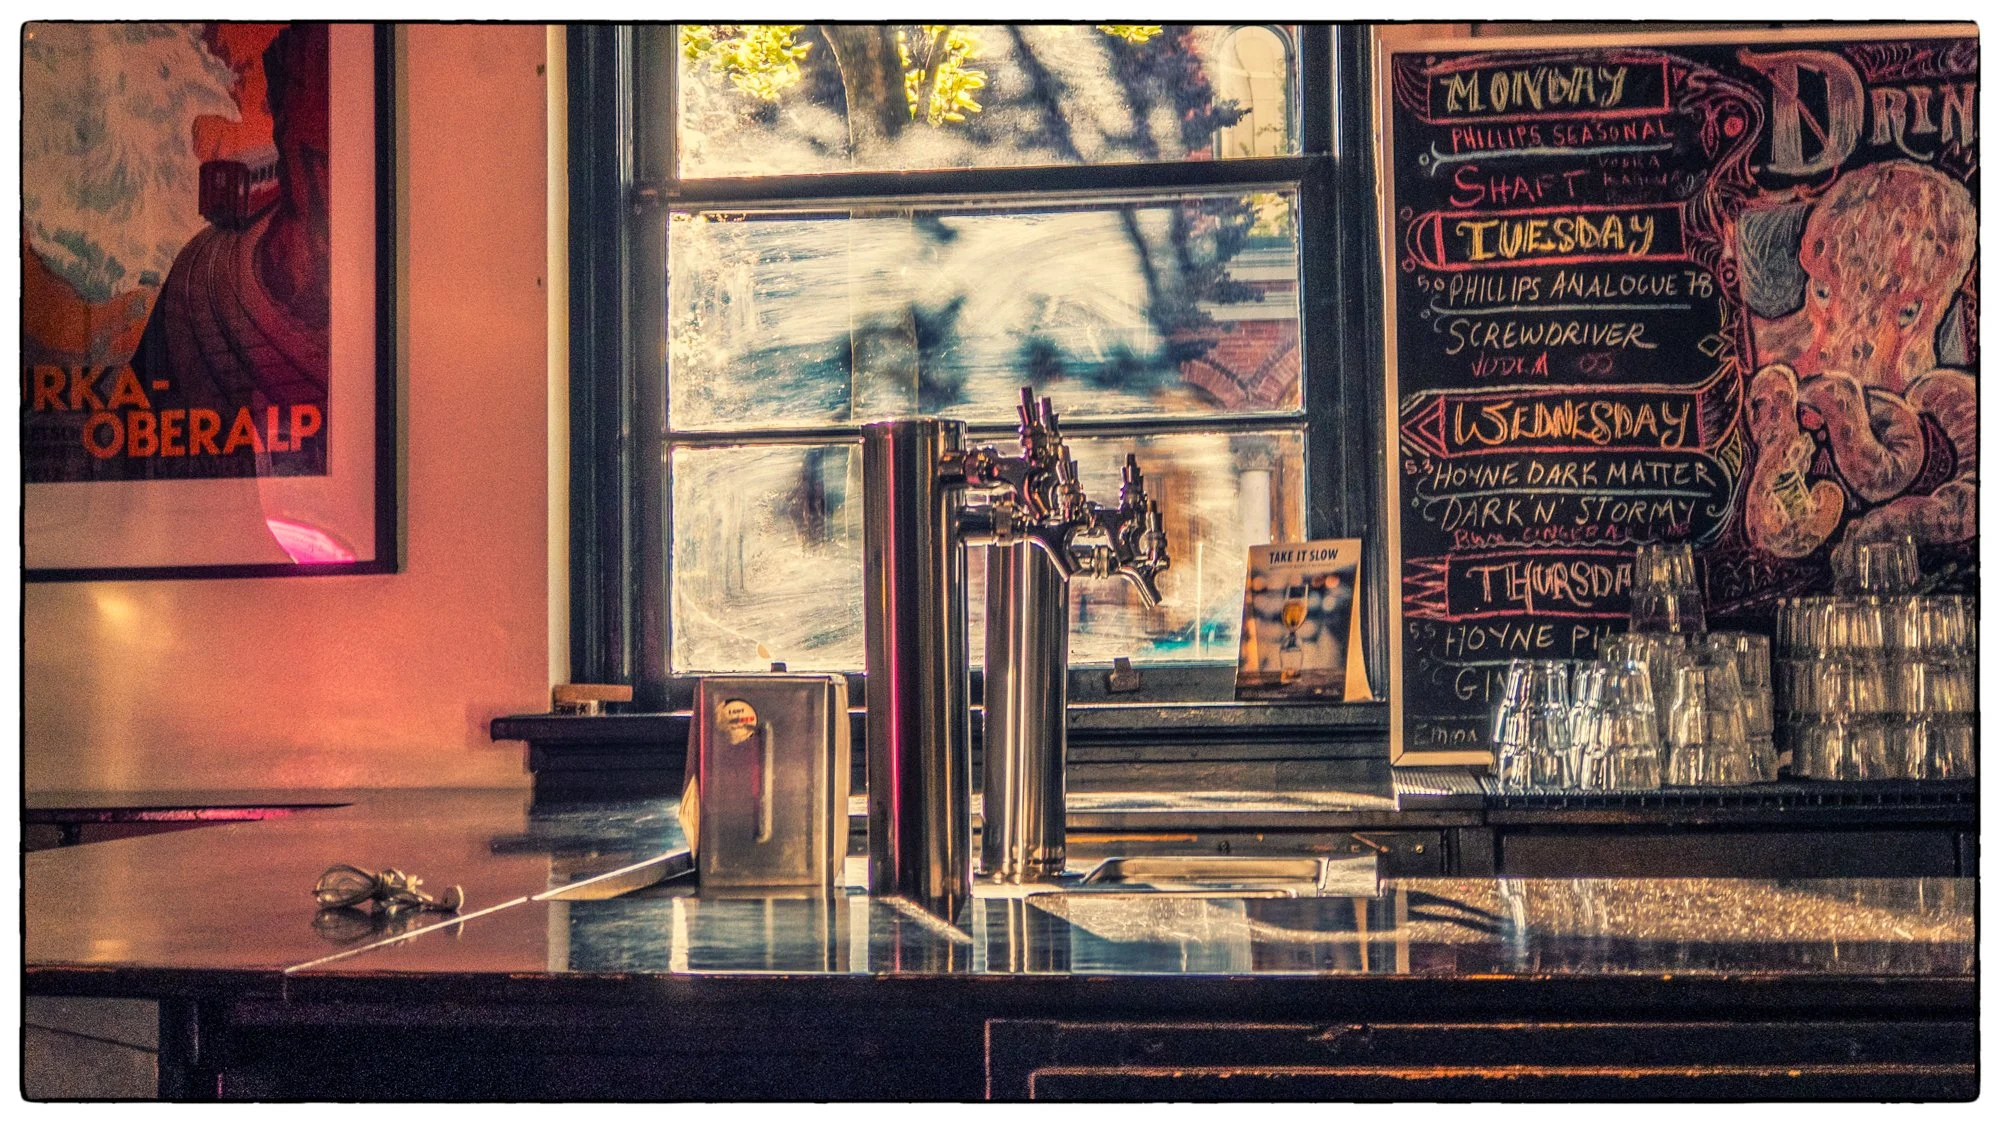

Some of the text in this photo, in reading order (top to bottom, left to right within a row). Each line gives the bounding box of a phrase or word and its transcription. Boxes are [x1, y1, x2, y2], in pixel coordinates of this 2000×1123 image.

[1441, 66, 1628, 112] MONDAY
[1451, 118, 1674, 153] PHILLIPS SEASONAL
[1449, 164, 1590, 208] SHAFT
[1456, 214, 1654, 261] TUESDAY
[1450, 273, 1542, 306] PHILLIPS
[1550, 270, 1677, 299] ANALOGUE
[1684, 270, 1713, 298] 78
[1447, 318, 1658, 355] SCREWDRIVER
[23, 359, 170, 412] RKA-
[81, 402, 323, 460] OBERALP
[1455, 399, 1690, 449] WEDNESDAY
[1433, 461, 1519, 491] HOYNE
[1527, 460, 1598, 487] DARK
[1606, 459, 1716, 487] MATTER
[1440, 495, 1524, 531] DARK
[1575, 495, 1695, 526] STORMY
[1269, 548, 1339, 564] TAKE IT SLOW
[1466, 560, 1633, 614] THURSDA
[1445, 622, 1555, 657] HOYNE
